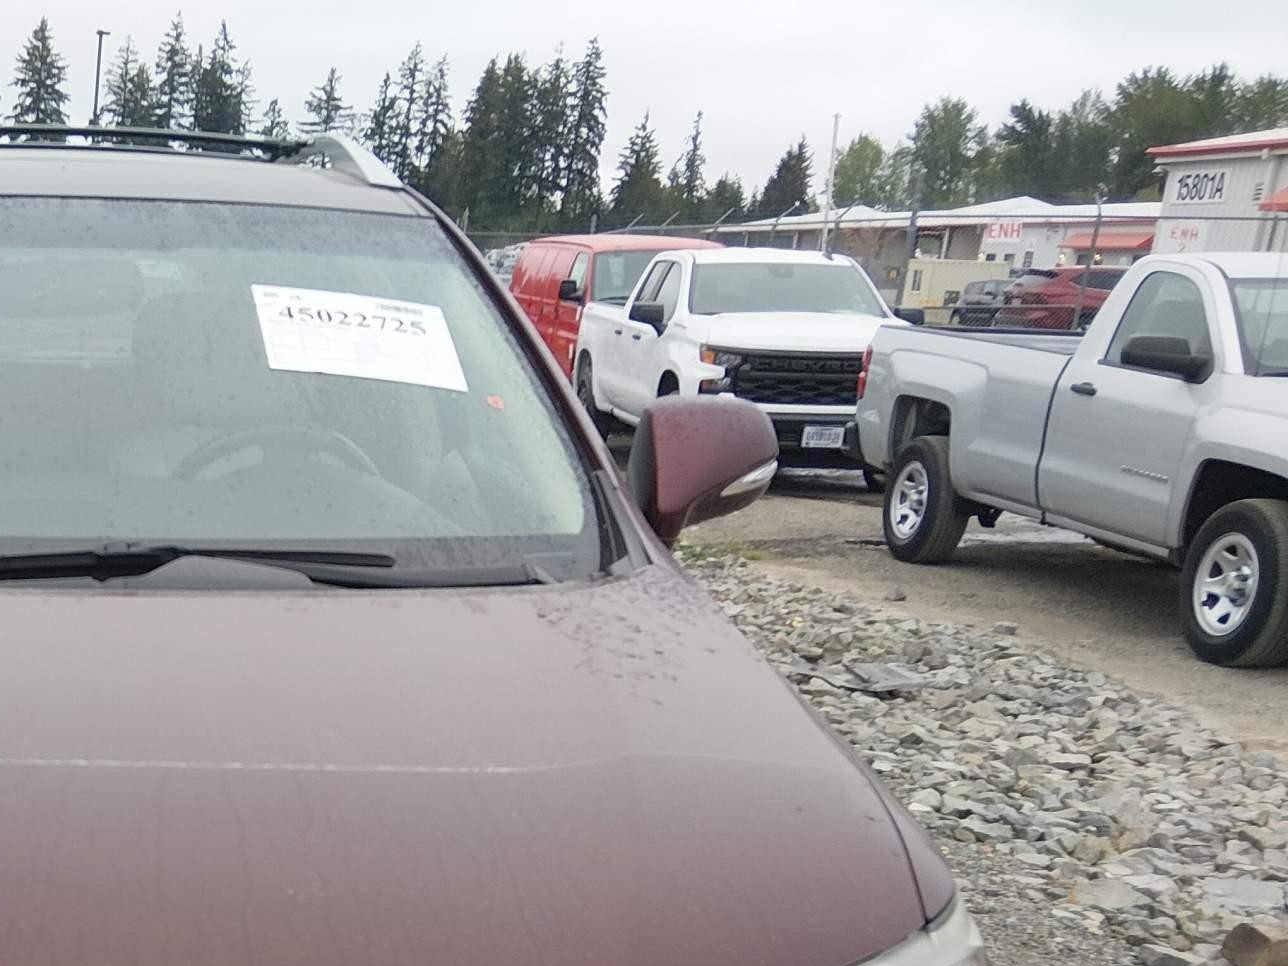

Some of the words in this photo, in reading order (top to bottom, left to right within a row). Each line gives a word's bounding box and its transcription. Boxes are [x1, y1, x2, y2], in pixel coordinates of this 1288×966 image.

[1177, 171, 1225, 201] 15801A
[987, 222, 1021, 239] ENH
[1169, 226, 1199, 241] ENH
[278, 305, 428, 337] 45022725
